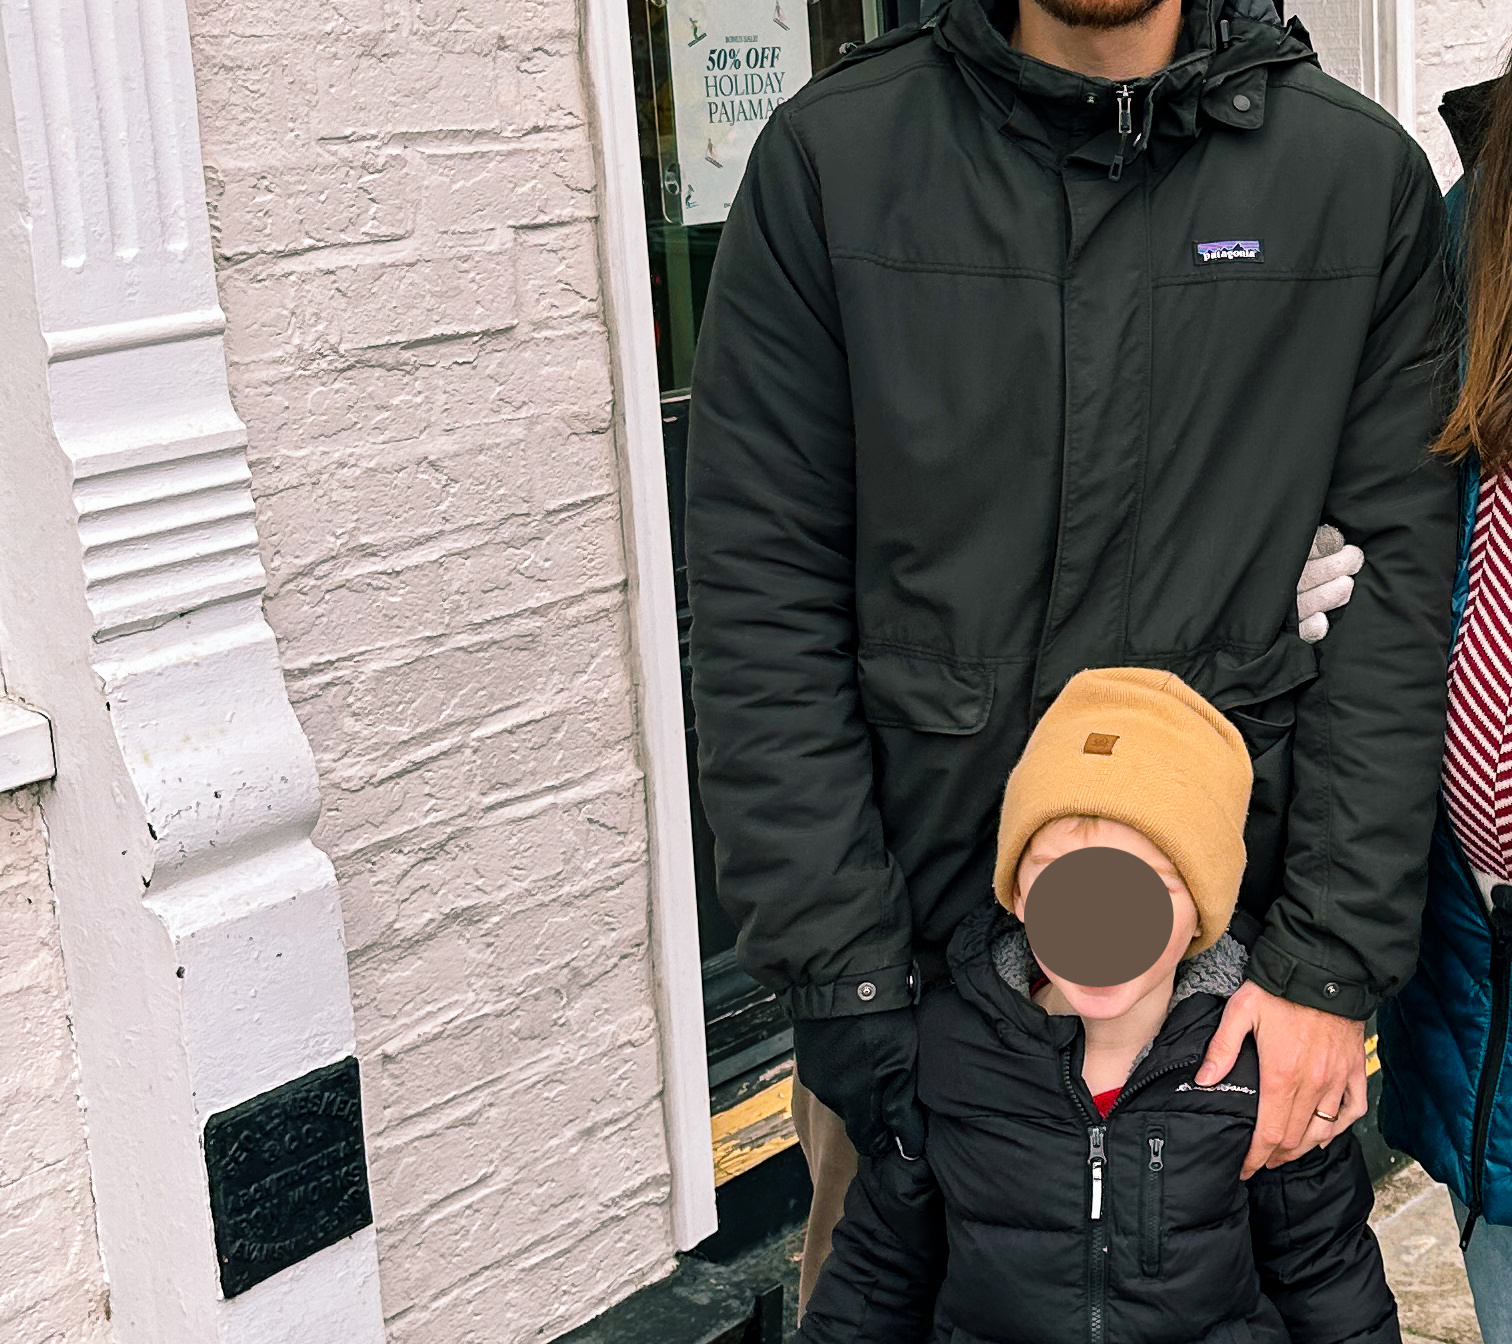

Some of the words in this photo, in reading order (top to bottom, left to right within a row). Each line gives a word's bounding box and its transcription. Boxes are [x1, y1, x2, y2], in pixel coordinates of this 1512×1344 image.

[706, 48, 741, 71] 50%
[746, 46, 782, 69] OFF
[704, 72, 786, 97] HOLIDAY
[1203, 249, 1256, 262] patagonia
